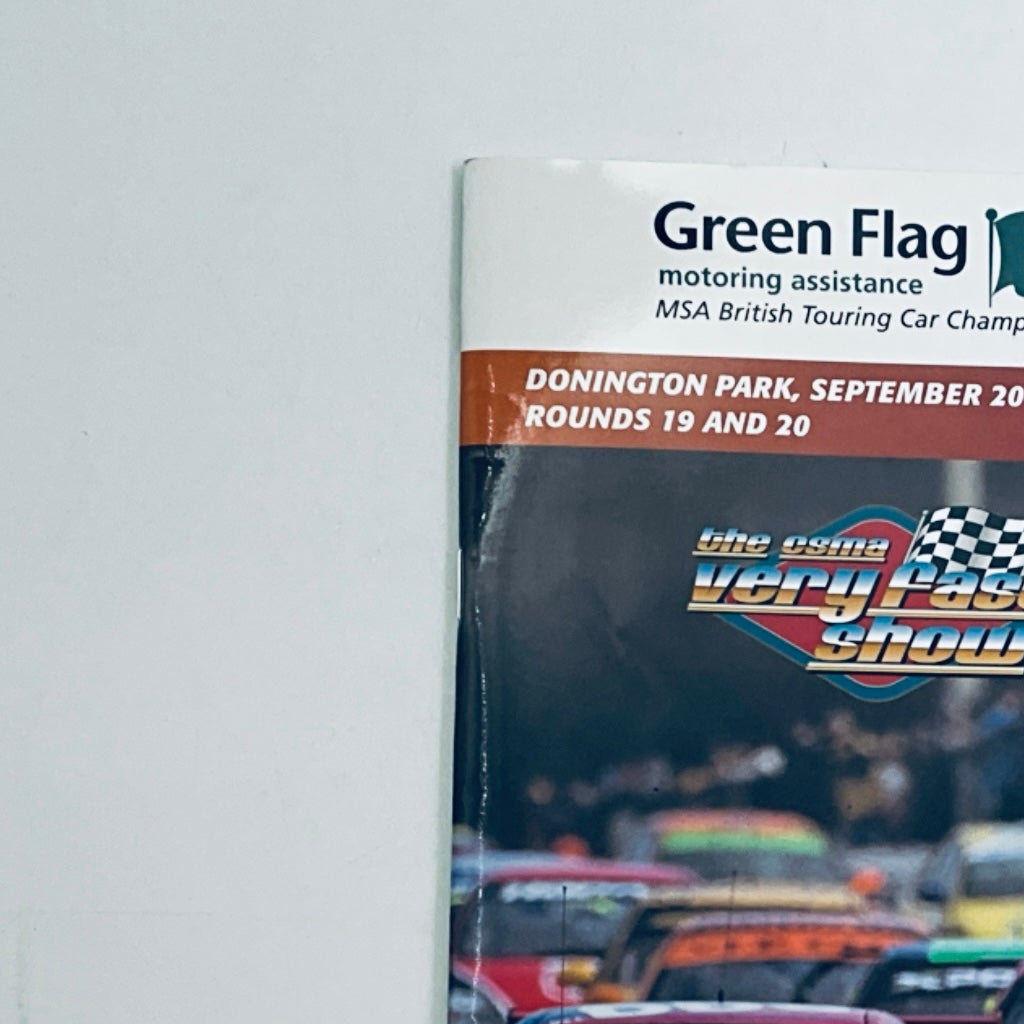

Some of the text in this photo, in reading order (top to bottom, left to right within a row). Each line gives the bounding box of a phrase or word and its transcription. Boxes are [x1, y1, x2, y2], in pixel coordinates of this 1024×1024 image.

[654, 201, 968, 275] Green Flag
[658, 266, 924, 296] motoring assistance
[655, 299, 712, 322] MSA
[718, 301, 794, 326] British
[802, 305, 892, 333] Touring
[900, 308, 941, 331] Car
[525, 368, 707, 399] DONINGTON
[714, 375, 802, 404] PARK,
[810, 378, 983, 408] SEPTEMBER
[524, 404, 811, 438] ROUNDS 19 AND 20
[696, 526, 891, 558] the csma
